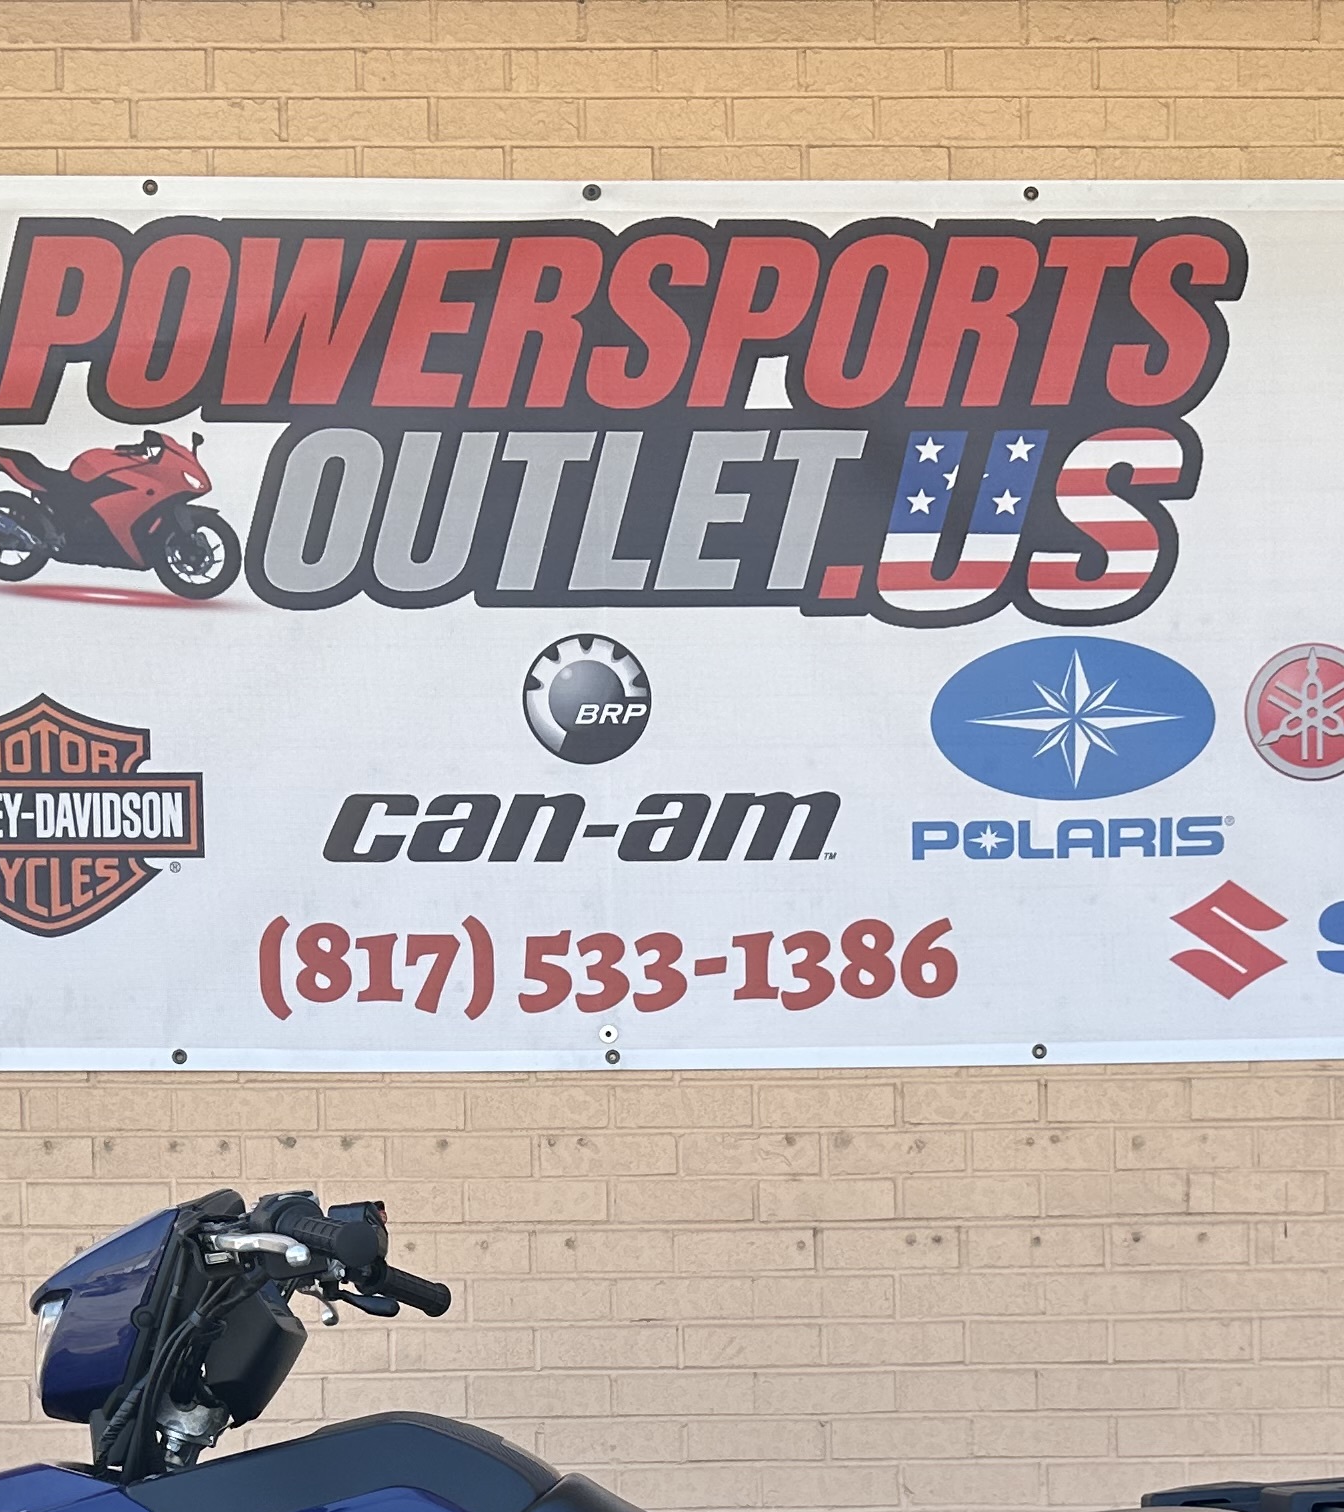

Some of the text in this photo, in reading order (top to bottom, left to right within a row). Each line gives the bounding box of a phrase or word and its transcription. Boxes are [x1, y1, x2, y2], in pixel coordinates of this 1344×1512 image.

[262, 425, 1185, 613] OUTLET.US
[574, 702, 648, 725] BRP
[321, 790, 842, 863] can-am
[911, 815, 1226, 861] POLARIS
[258, 914, 960, 1022] (817) 533-1386
